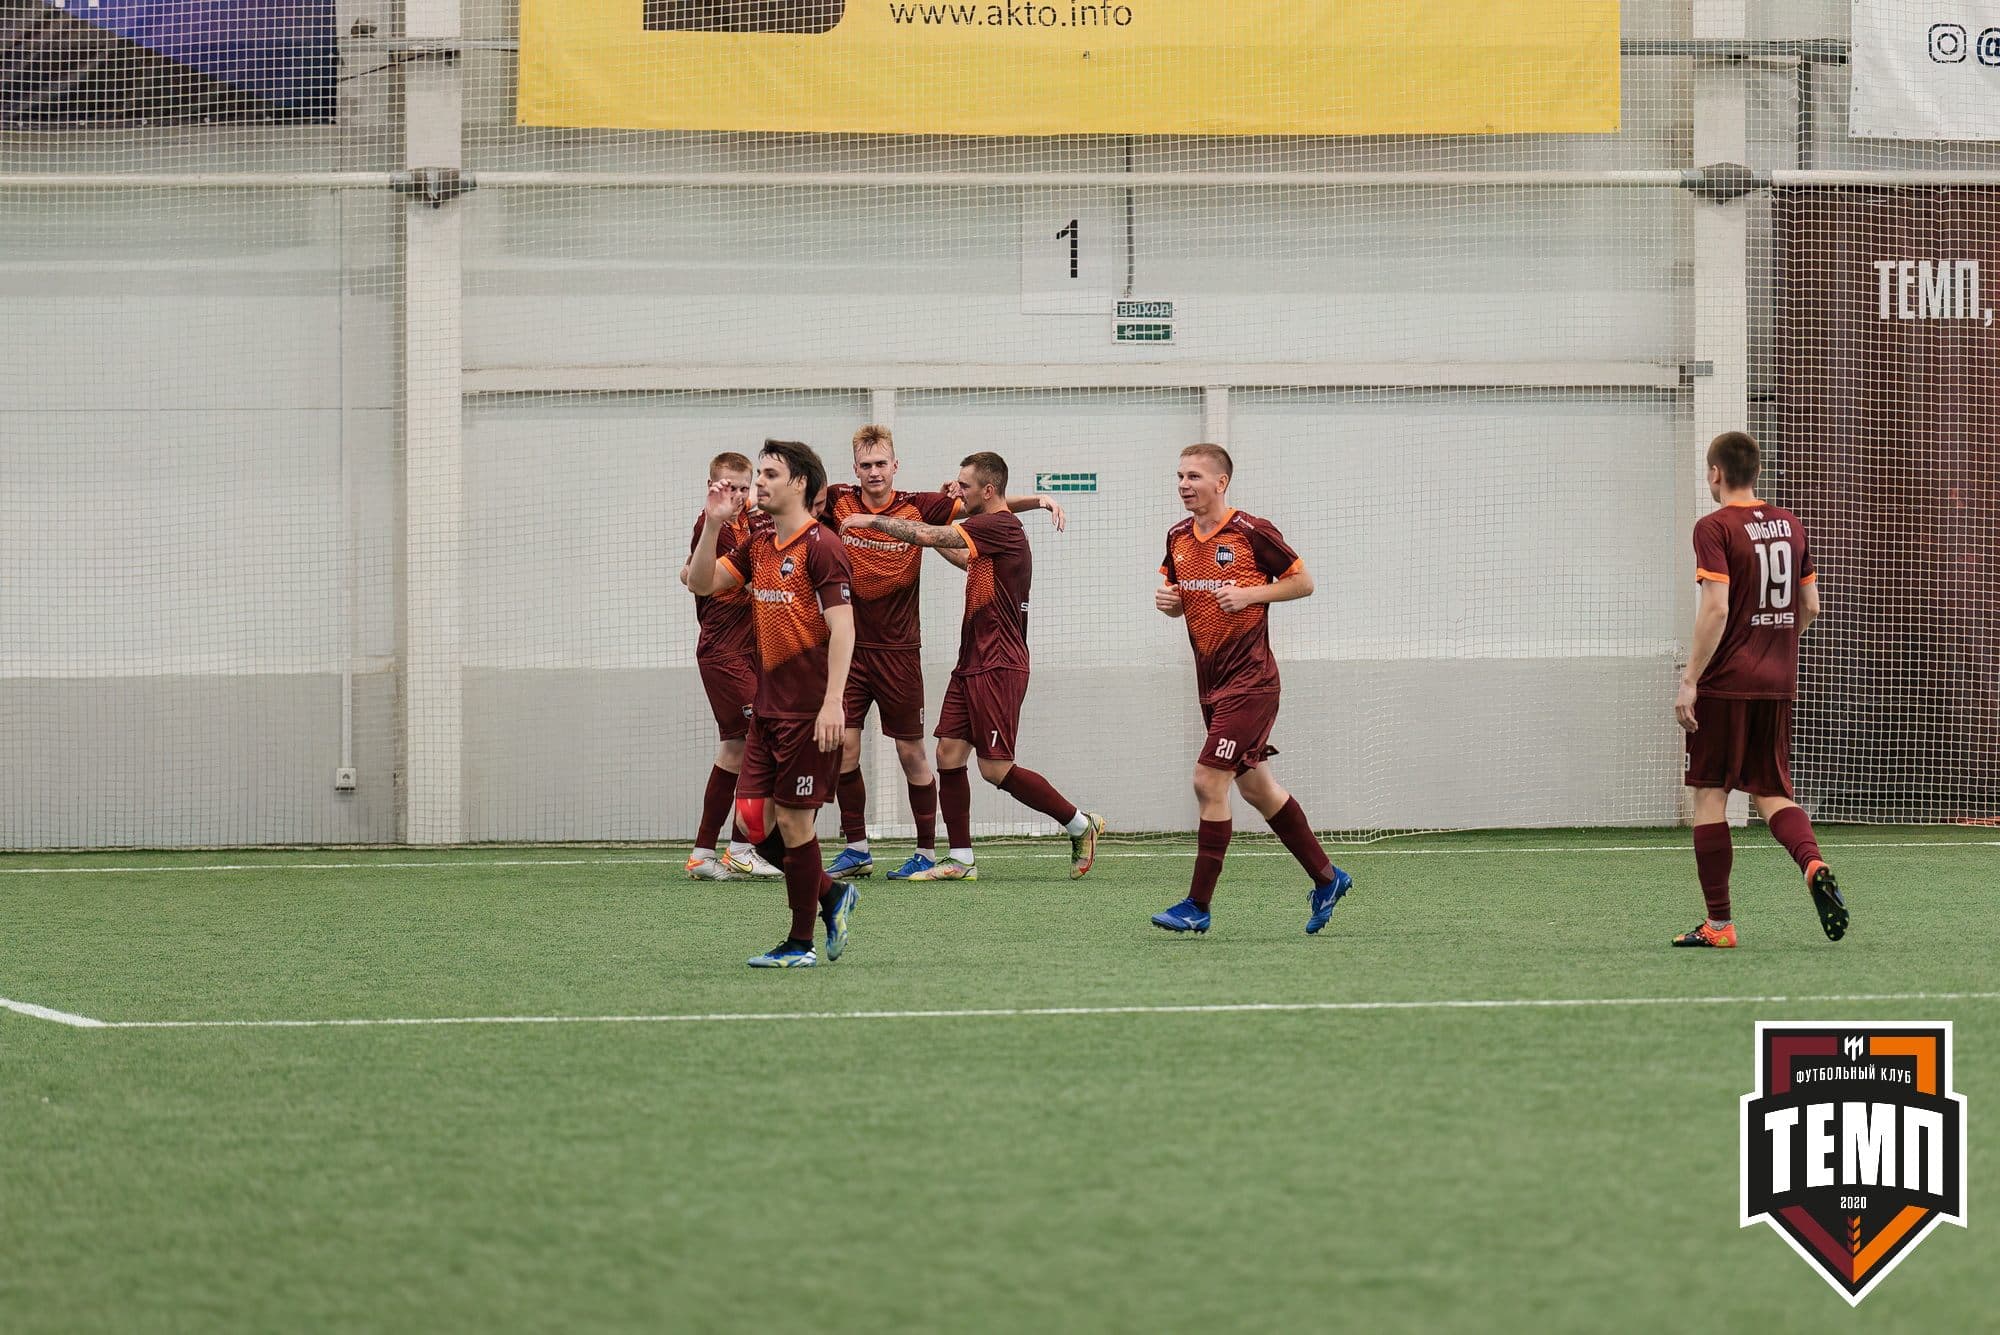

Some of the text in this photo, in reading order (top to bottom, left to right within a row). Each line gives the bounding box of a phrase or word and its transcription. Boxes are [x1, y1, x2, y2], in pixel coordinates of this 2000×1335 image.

[890, 0, 1132, 27] www.akto.info
[1055, 219, 1078, 278] 1
[1873, 260, 1993, 327] ТЕМП,
[1118, 302, 1172, 317] ВЫХОД
[1754, 541, 1792, 609] 19
[991, 730, 998, 748] 7
[1214, 737, 1237, 760] 20
[796, 775, 814, 796] 23
